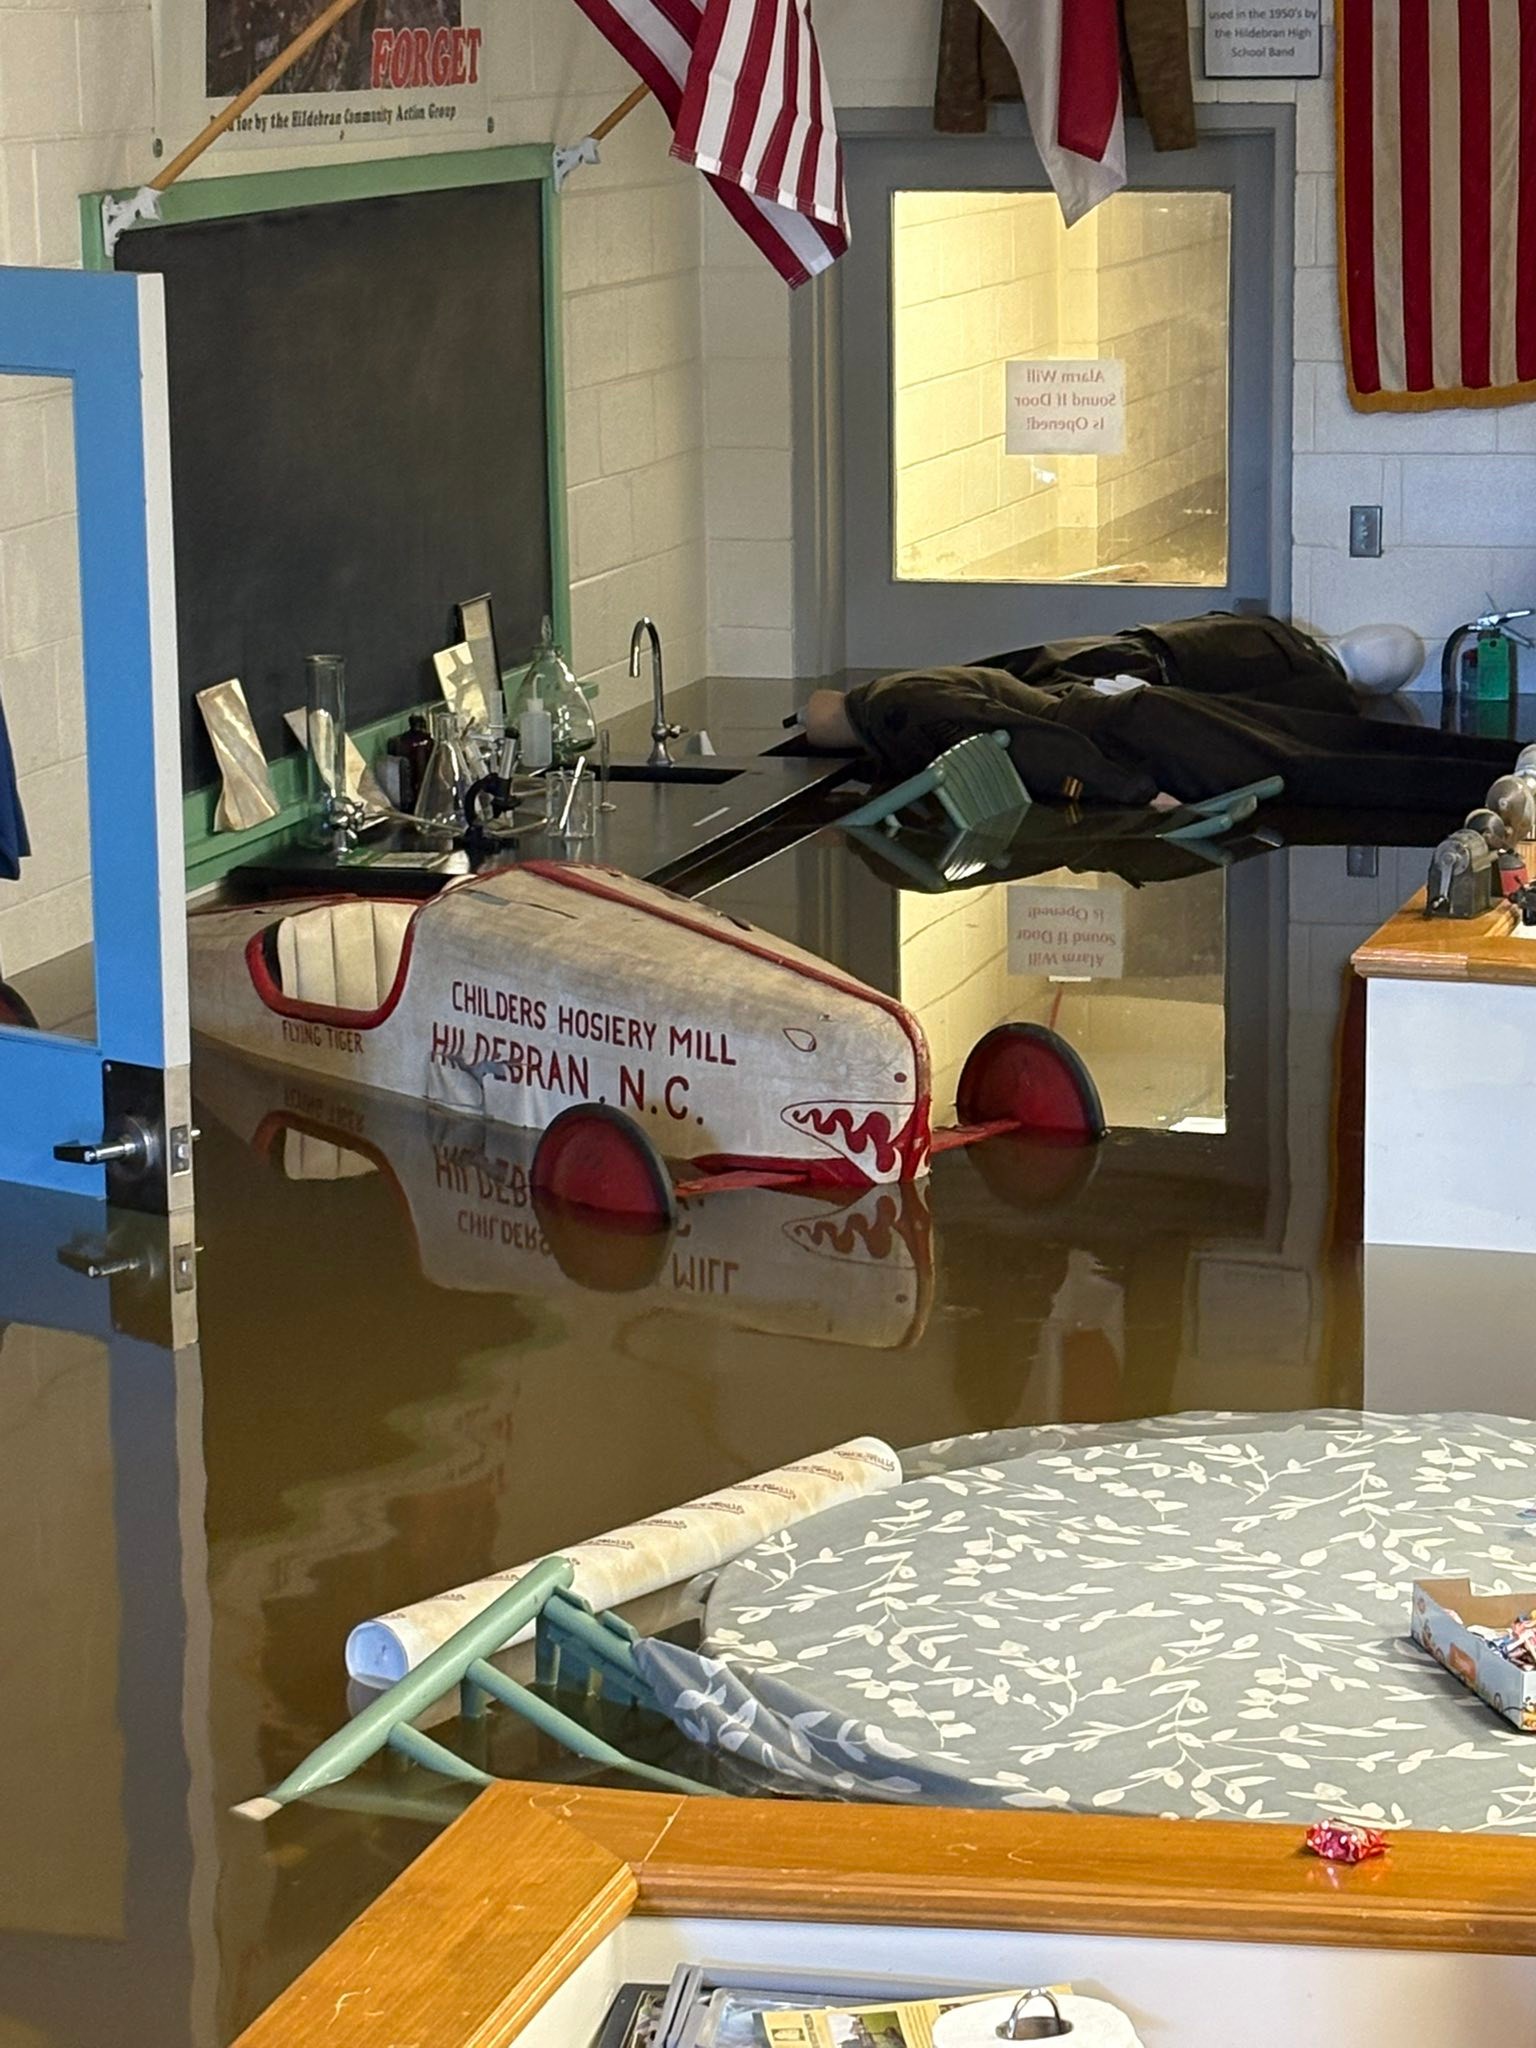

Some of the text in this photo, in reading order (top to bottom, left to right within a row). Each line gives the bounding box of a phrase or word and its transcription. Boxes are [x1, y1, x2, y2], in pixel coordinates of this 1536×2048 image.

[1209, 8, 1317, 21] used in the 1950's by
[1215, 28, 1312, 40] the Hildebran High
[371, 27, 482, 89] FORGET
[1231, 47, 1295, 57] School Band
[254, 113, 268, 133] by
[270, 111, 289, 129] the
[291, 108, 342, 128] Hildebran
[344, 105, 393, 126] Community
[396, 104, 425, 121] Action
[428, 102, 457, 121] Group
[282, 1020, 364, 1054] FLYING TIGER
[452, 981, 737, 1066] CHILDERS HOSIERY MILL
[619, 1065, 704, 1125] N.C.
